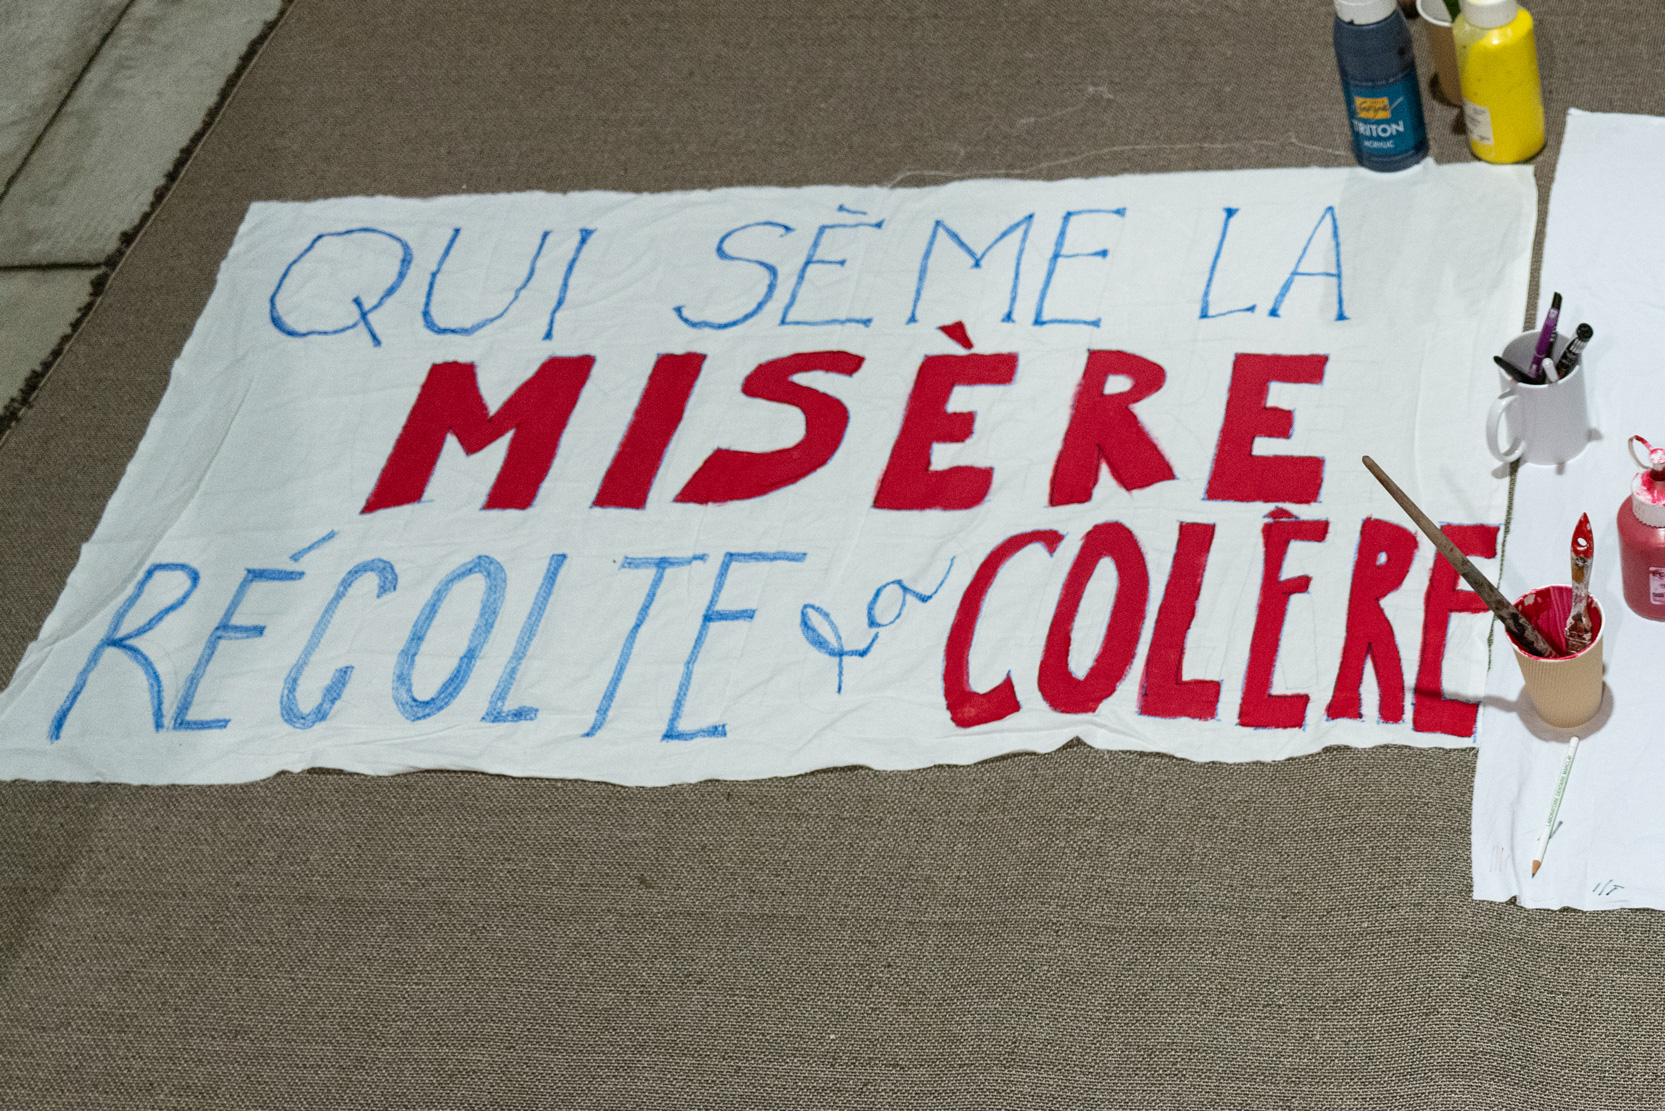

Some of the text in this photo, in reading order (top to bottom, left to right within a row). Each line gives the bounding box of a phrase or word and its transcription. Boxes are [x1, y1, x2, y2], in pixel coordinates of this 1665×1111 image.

[1352, 120, 1404, 138] TRITON
[268, 203, 1348, 348] QUI SÈME LA
[359, 320, 1330, 516] MISÈRE
[47, 529, 808, 743] RÉCOLTE
[942, 506, 1502, 743] COLÈRE
